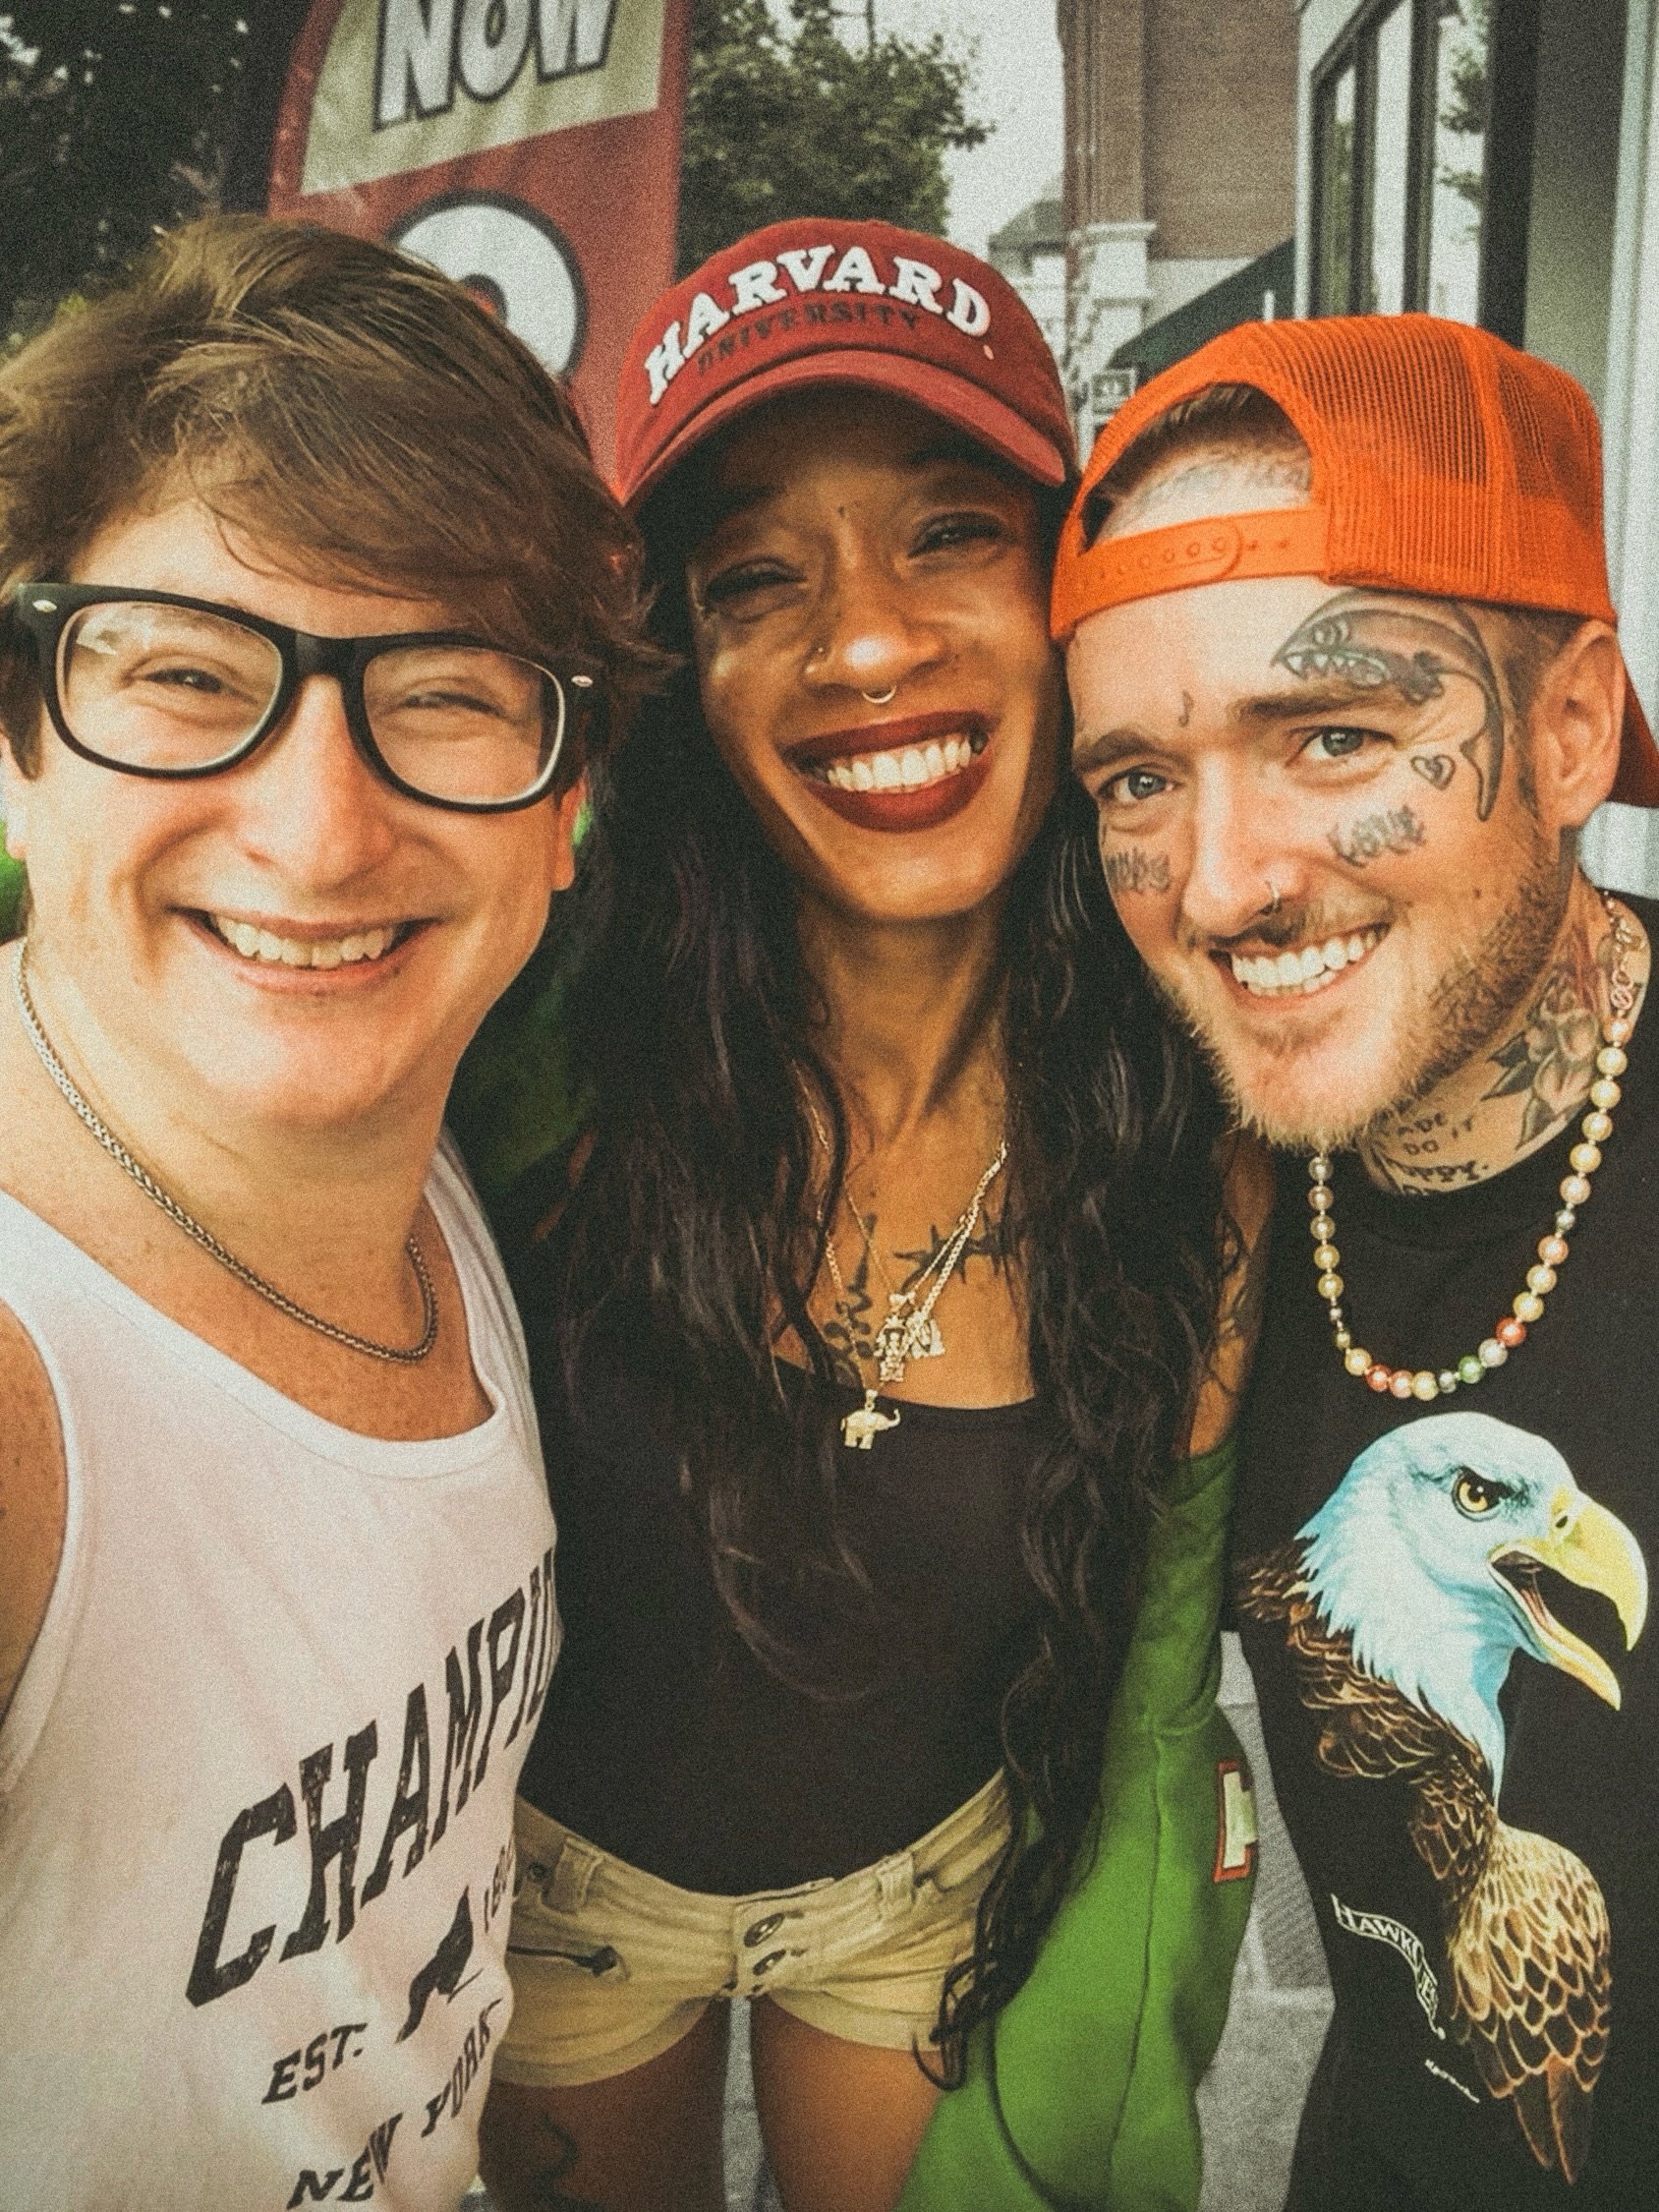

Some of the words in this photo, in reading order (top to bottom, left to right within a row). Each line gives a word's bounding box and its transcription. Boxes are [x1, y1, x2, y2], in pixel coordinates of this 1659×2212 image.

[374, 0, 617, 130] NOW
[644, 245, 992, 406] HARVARD
[697, 300, 920, 377] UNIVERSITY
[261, 2022, 368, 2104] EST.
[286, 2113, 403, 2211] NEW
[421, 1997, 503, 2137] YORK
